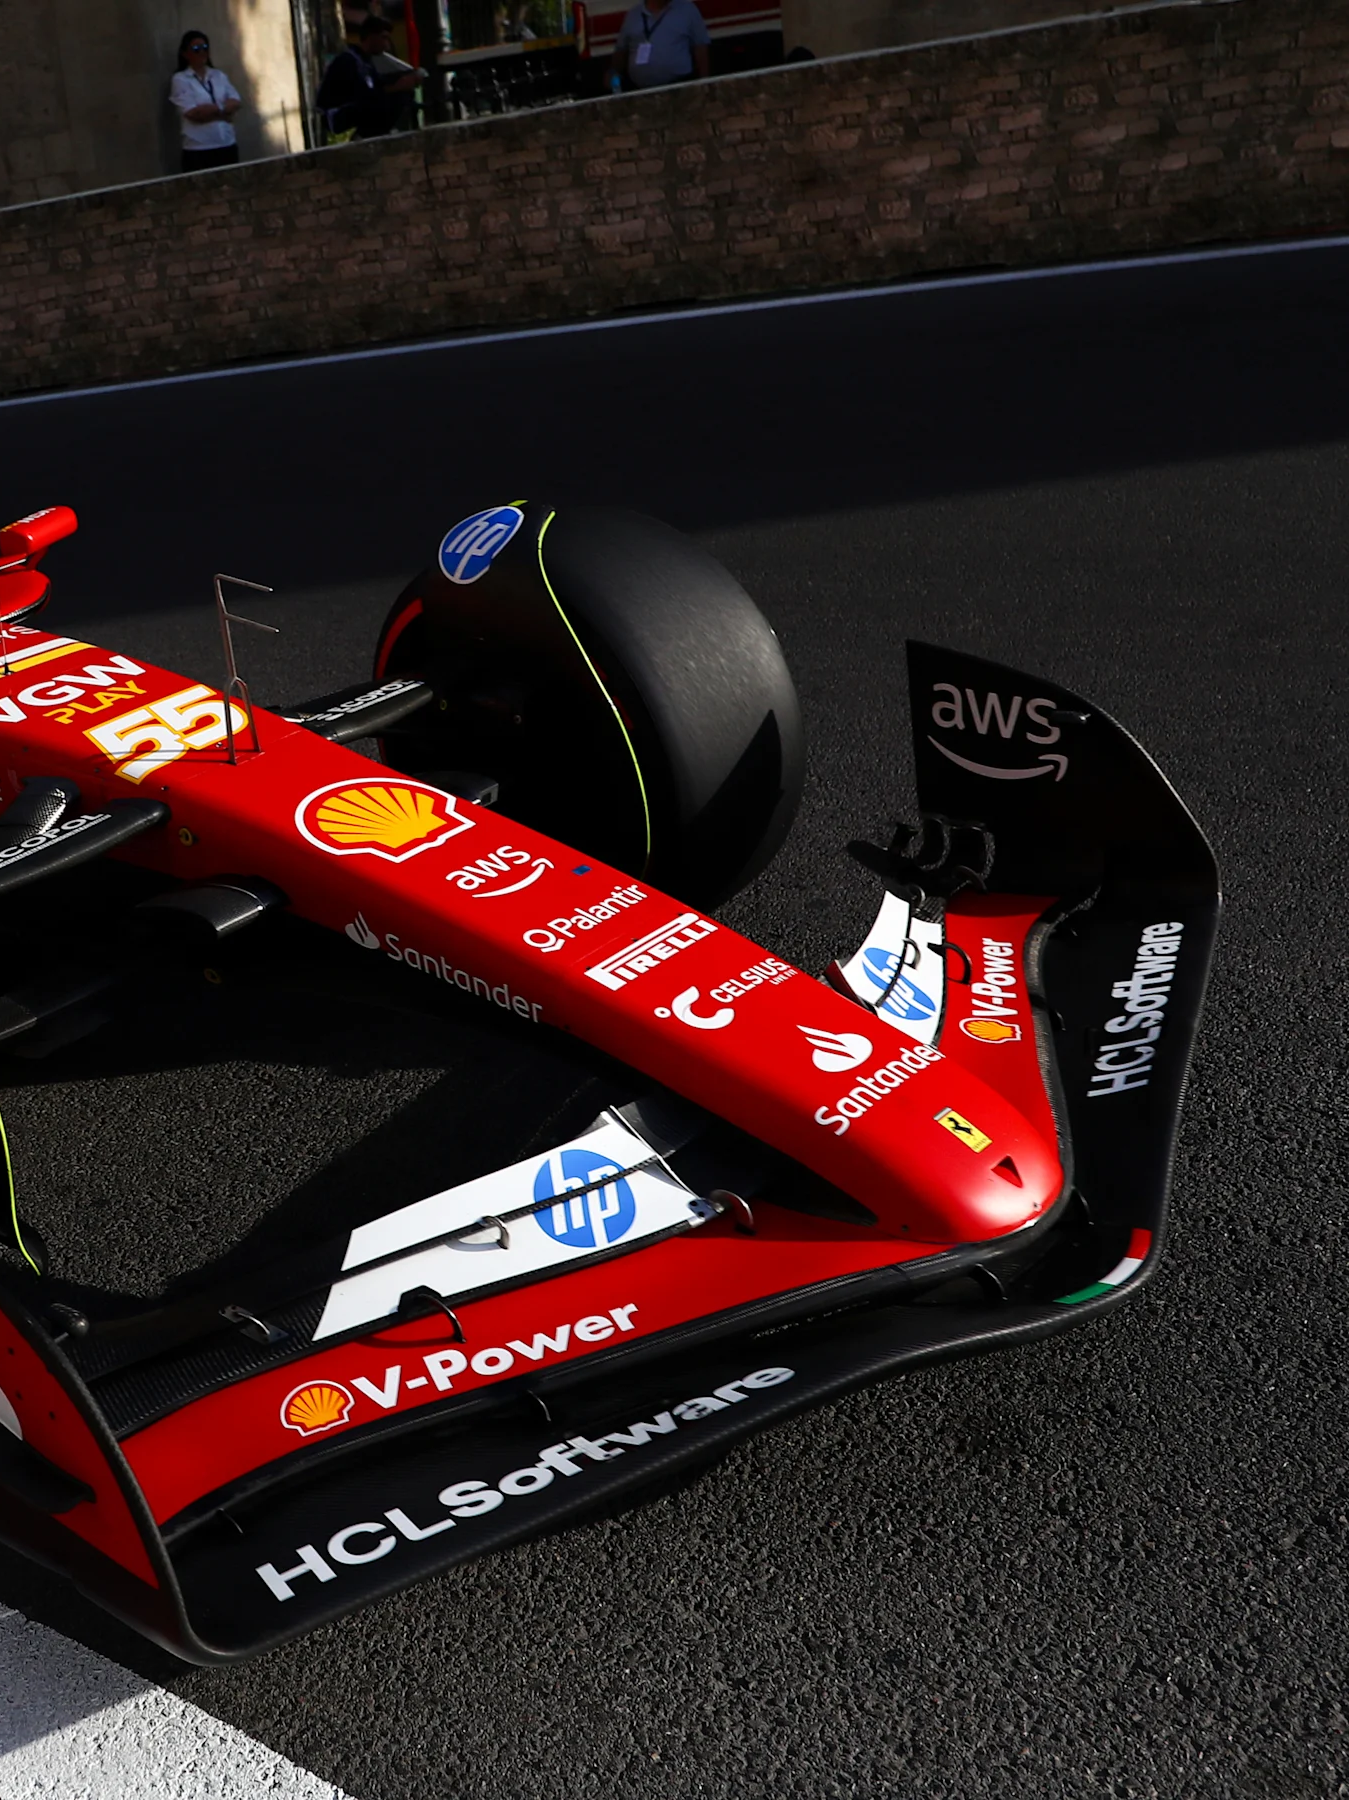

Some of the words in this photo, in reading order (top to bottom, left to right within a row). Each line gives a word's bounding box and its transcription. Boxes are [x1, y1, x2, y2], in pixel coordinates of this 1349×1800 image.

[444, 507, 512, 581] hp
[42, 680, 148, 725] PLAY
[82, 683, 250, 785] 55
[930, 682, 1062, 745] aws
[445, 845, 531, 890] aws
[547, 884, 648, 939] Palantir
[583, 912, 719, 991] PIRELLI
[383, 933, 543, 1024] Santander
[709, 957, 791, 1003] CELSIUS
[970, 937, 1019, 1017] V-Power
[1085, 921, 1185, 1099] HCLSoftware
[813, 1044, 947, 1137] Santander
[549, 1149, 621, 1248] hp
[350, 1303, 640, 1409] V-Power
[254, 1366, 796, 1602] HCLSoftware
